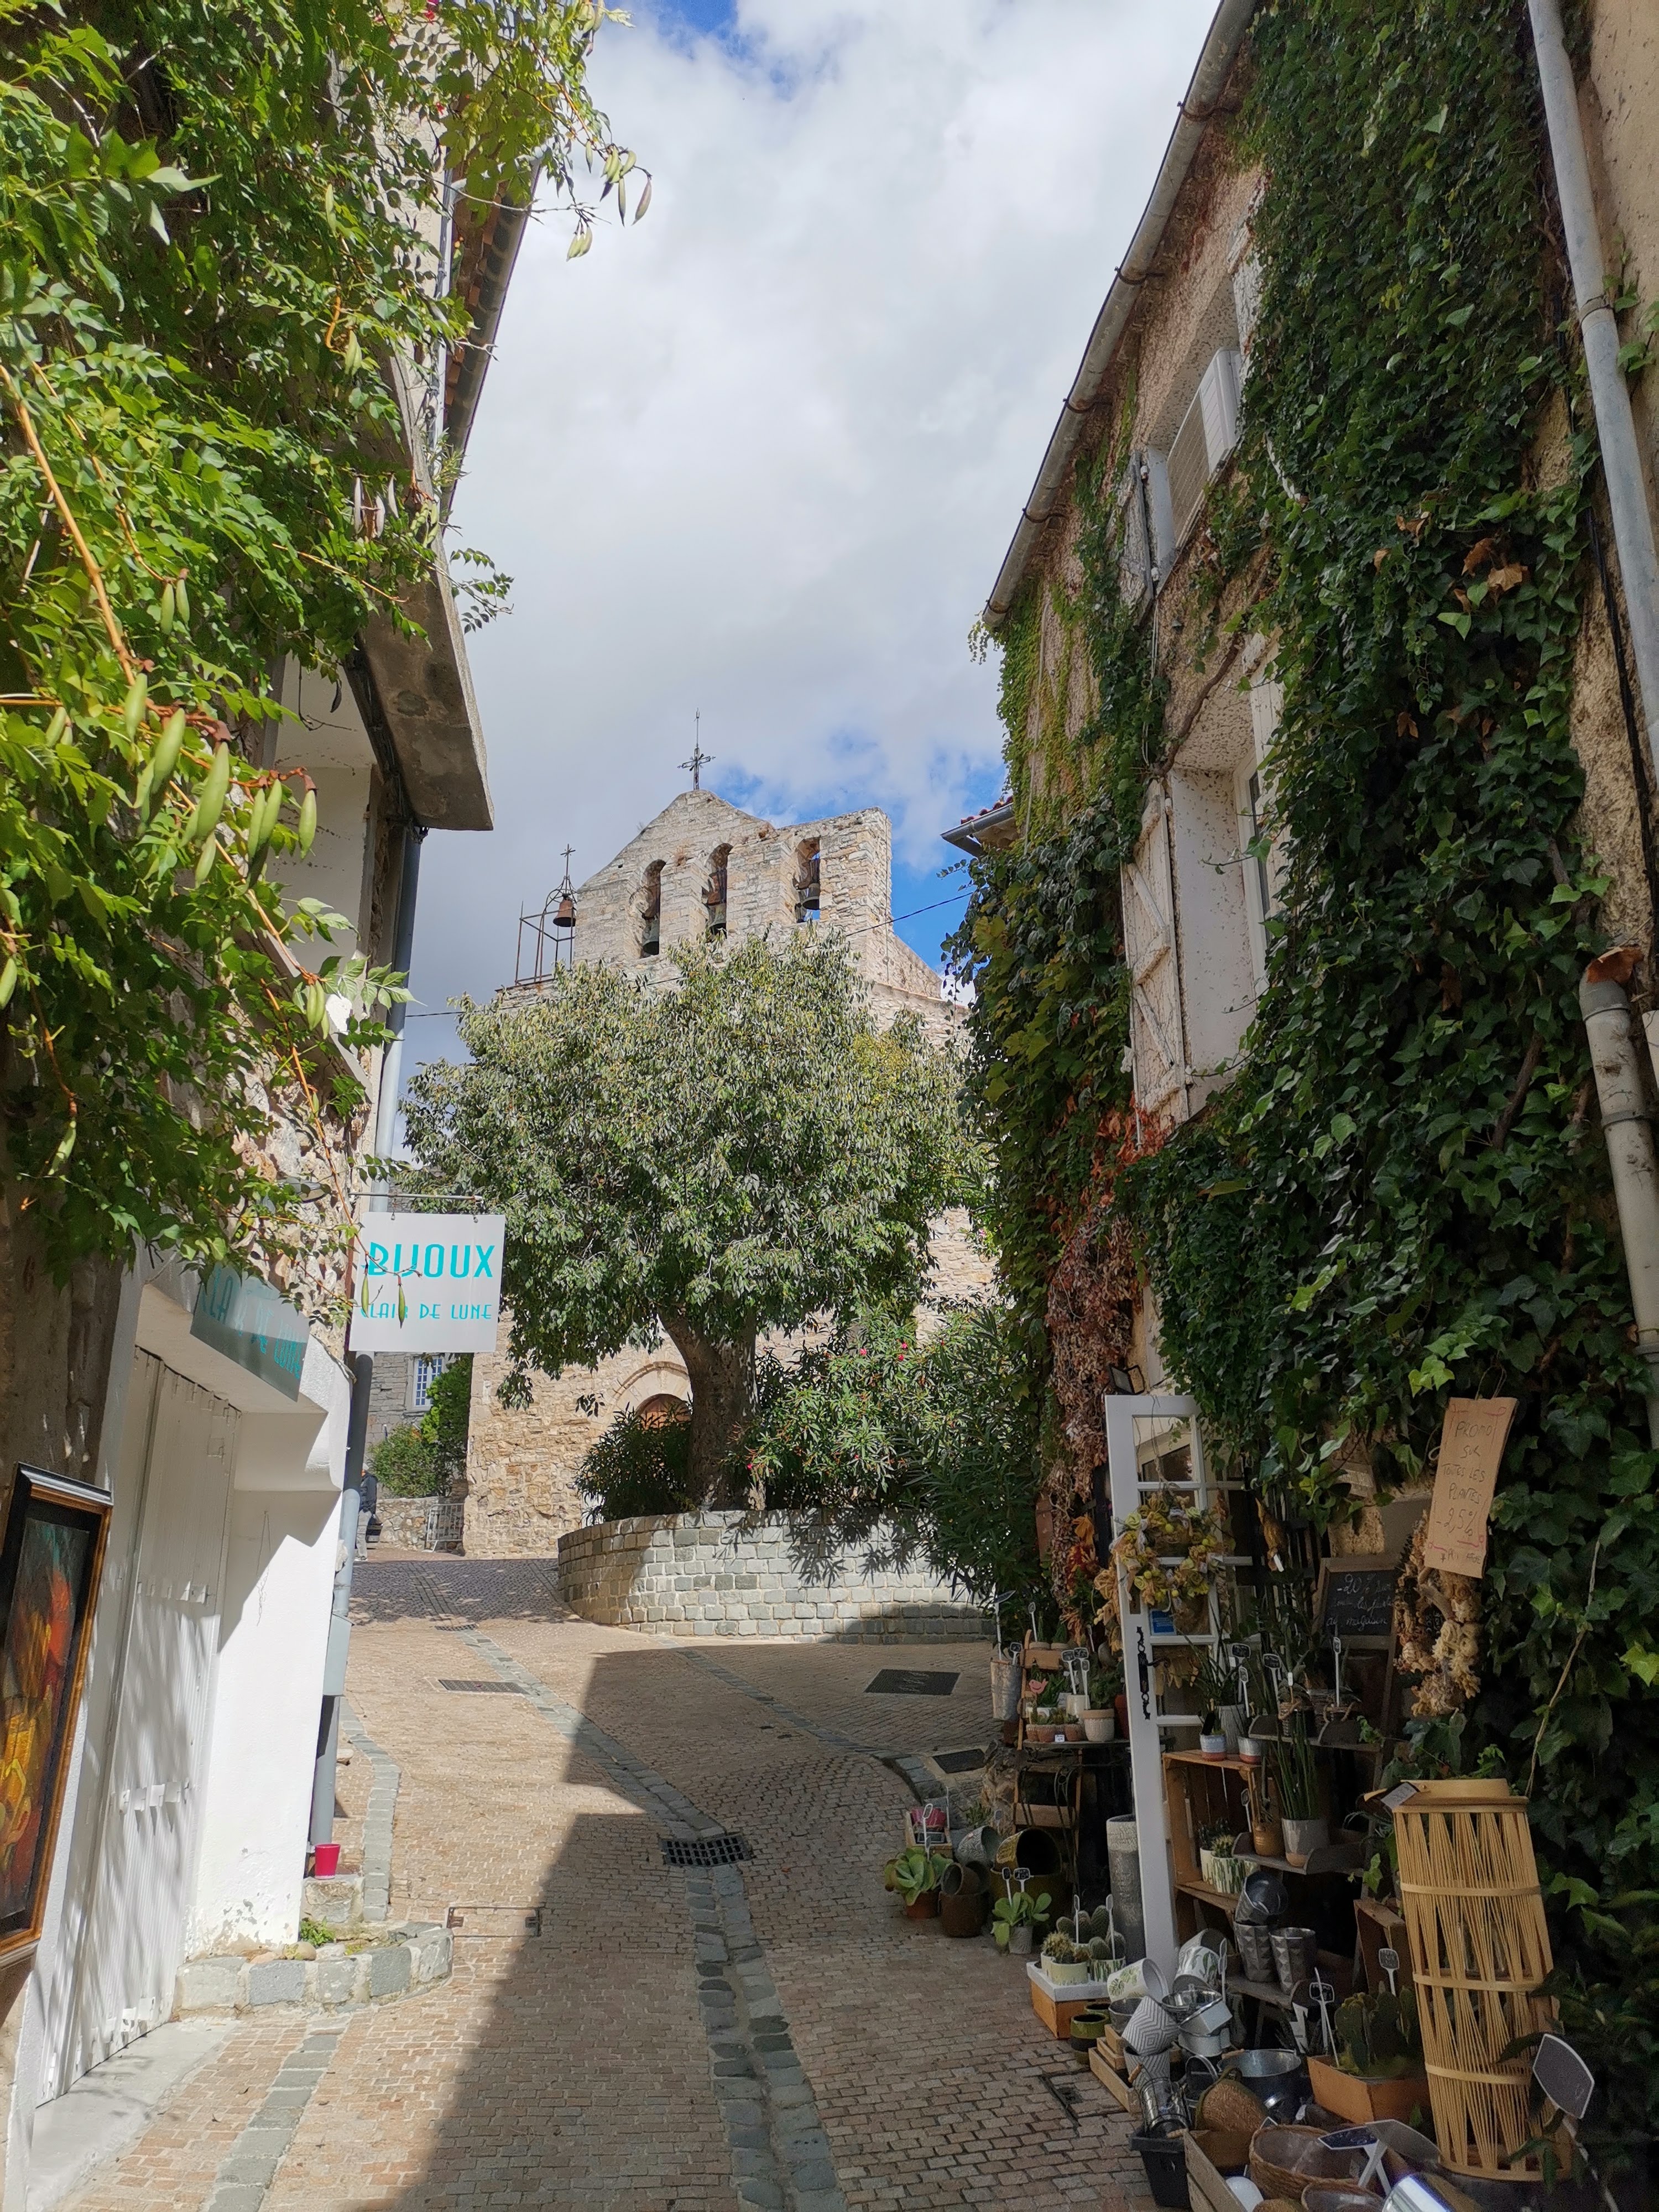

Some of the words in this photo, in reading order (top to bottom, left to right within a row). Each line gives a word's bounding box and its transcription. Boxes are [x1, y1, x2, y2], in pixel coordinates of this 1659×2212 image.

[361, 1241, 495, 1277] BIJOUX
[361, 1302, 408, 1318] LAI
[419, 1303, 441, 1319] DE
[451, 1304, 492, 1319] LUNE
[1454, 1421, 1493, 1438] PROMO
[1460, 1445, 1480, 1459] SUR
[1468, 1467, 1485, 1483] LES
[1449, 1483, 1482, 1504] PLANTES
